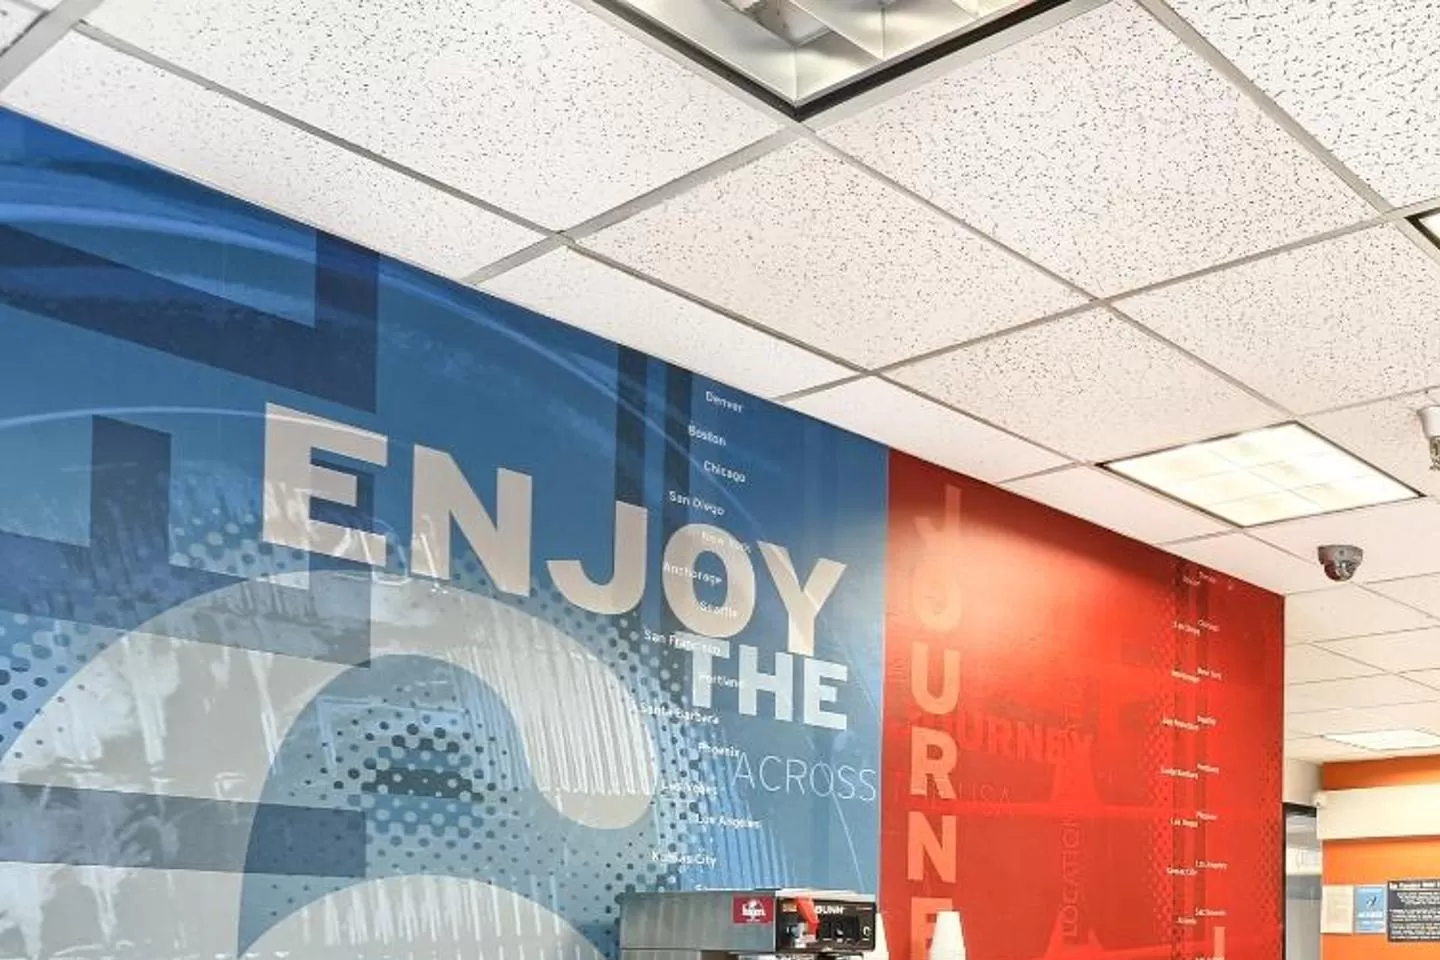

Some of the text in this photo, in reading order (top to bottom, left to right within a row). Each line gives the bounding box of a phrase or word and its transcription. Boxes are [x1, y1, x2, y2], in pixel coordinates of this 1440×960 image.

[705, 390, 743, 413] Denver
[688, 423, 727, 447] Boston
[703, 459, 746, 484] Chicago
[669, 490, 725, 517] San Diego
[263, 402, 846, 656] ENJOY
[674, 631, 848, 731] THE
[732, 750, 878, 803] ACROSS
